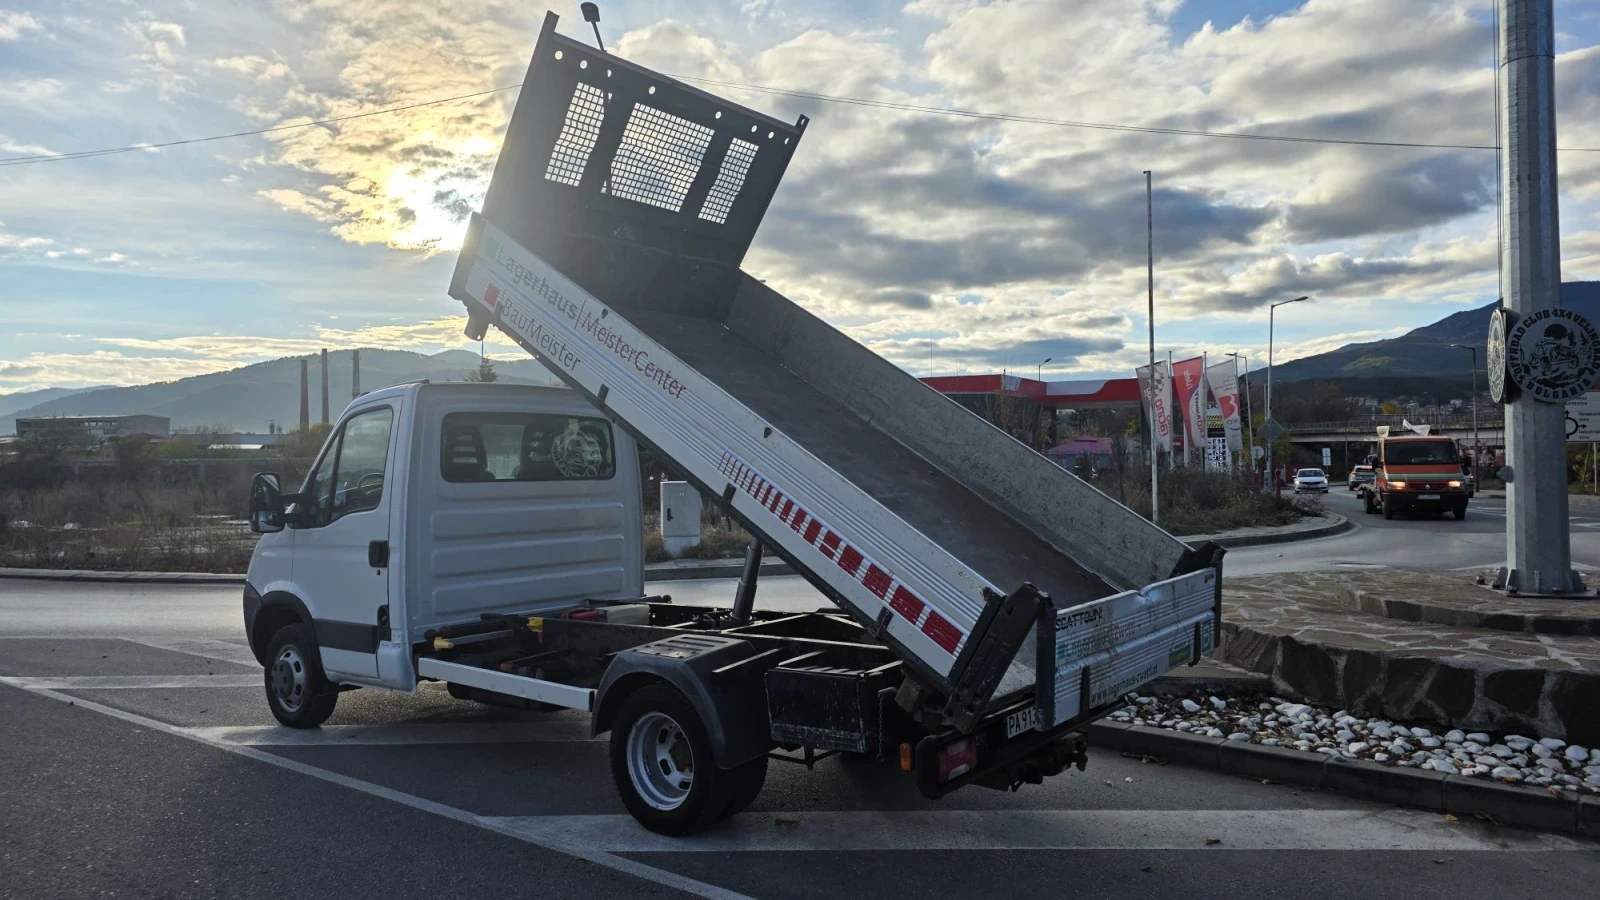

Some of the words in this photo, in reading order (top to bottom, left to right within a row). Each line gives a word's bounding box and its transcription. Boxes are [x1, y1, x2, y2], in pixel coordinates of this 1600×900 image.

[496, 244, 579, 319] Lagerhaus
[580, 310, 688, 399] MeisterCenter
[501, 296, 582, 371] BauMeister
[1509, 326, 1526, 376] OFFROAD
[1523, 309, 1551, 329] CLUB
[1525, 377, 1593, 399] BULGARIA
